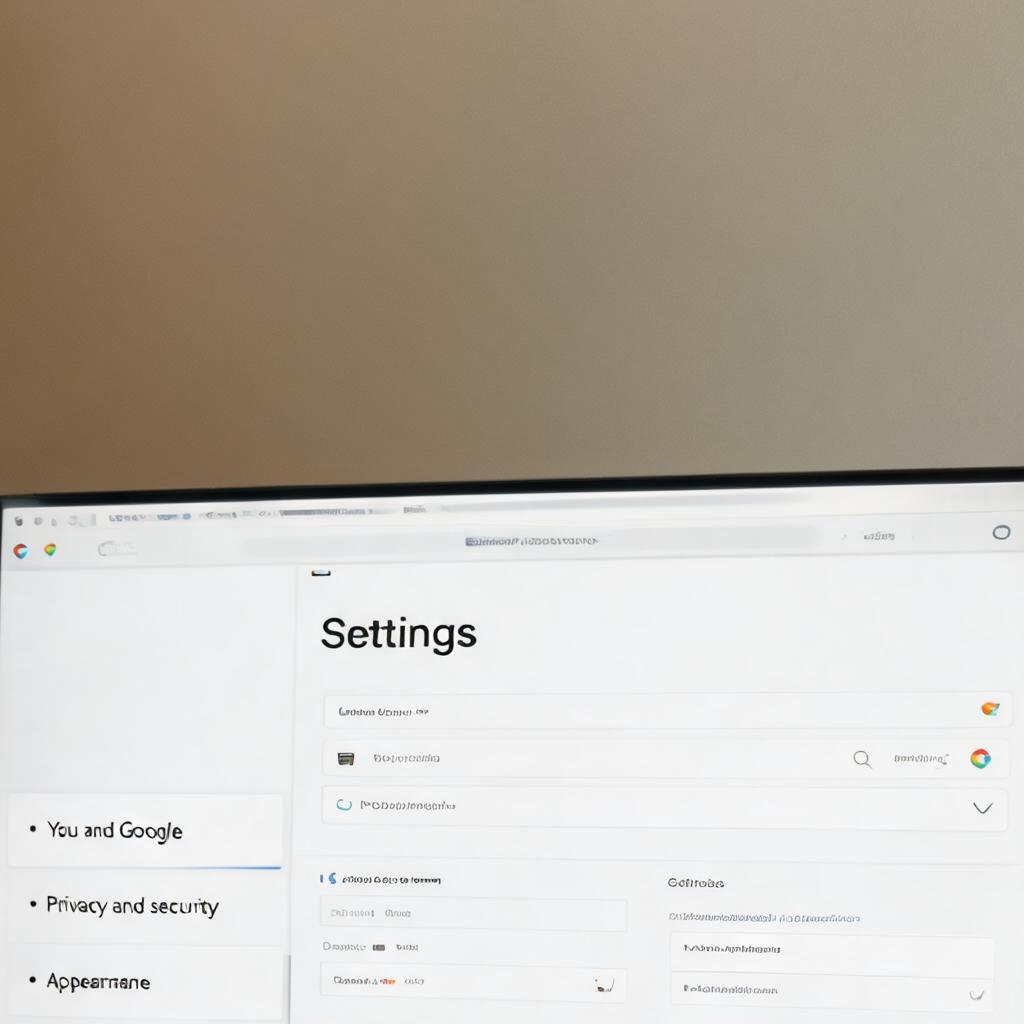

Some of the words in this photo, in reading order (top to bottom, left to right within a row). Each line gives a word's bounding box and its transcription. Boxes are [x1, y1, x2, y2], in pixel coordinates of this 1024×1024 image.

[320, 616, 478, 657] Settings
[47, 820, 79, 838] You
[84, 821, 115, 839] and
[119, 820, 183, 846] Google
[46, 895, 108, 919] Privacy
[112, 896, 145, 915] and
[150, 898, 220, 920] security
